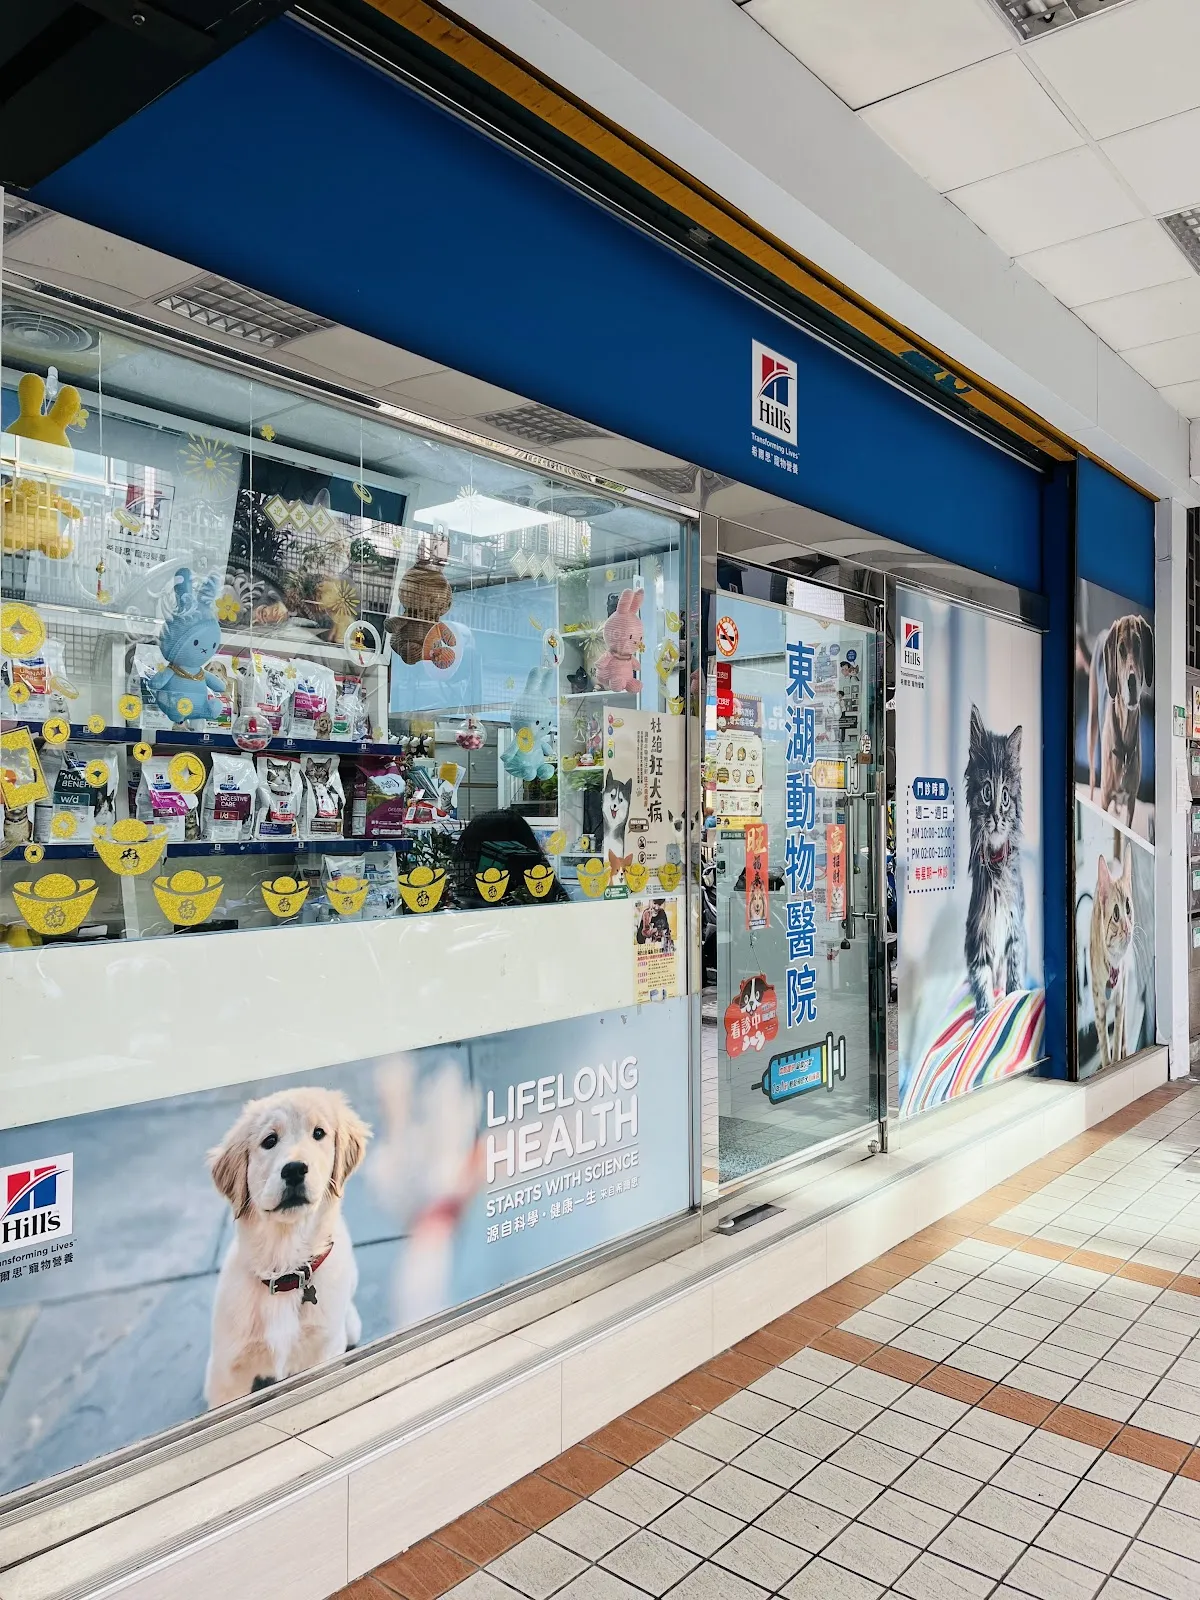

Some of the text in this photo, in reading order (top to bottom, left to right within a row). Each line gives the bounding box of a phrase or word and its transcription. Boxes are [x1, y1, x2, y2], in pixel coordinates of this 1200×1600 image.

[760, 400, 791, 434] Hill's
[751, 432, 799, 459] Transforming Lives
[904, 650, 921, 666] Hill's
[647, 717, 663, 822] 杜絕狂犬病
[60, 795, 79, 804] w/d
[917, 782, 945, 796] 門診時間
[785, 640, 817, 1029] 東湖動物醫院
[911, 827, 920, 839] AM
[912, 848, 920, 859] PM
[731, 1013, 760, 1039] 看診中
[487, 1056, 639, 1128] LIFELONG
[486, 1094, 639, 1184] HEALTH
[486, 1151, 639, 1218] STARTS WITH SCIENCE
[2, 1211, 61, 1244] Hill's
[51, 1241, 74, 1254] Lives
